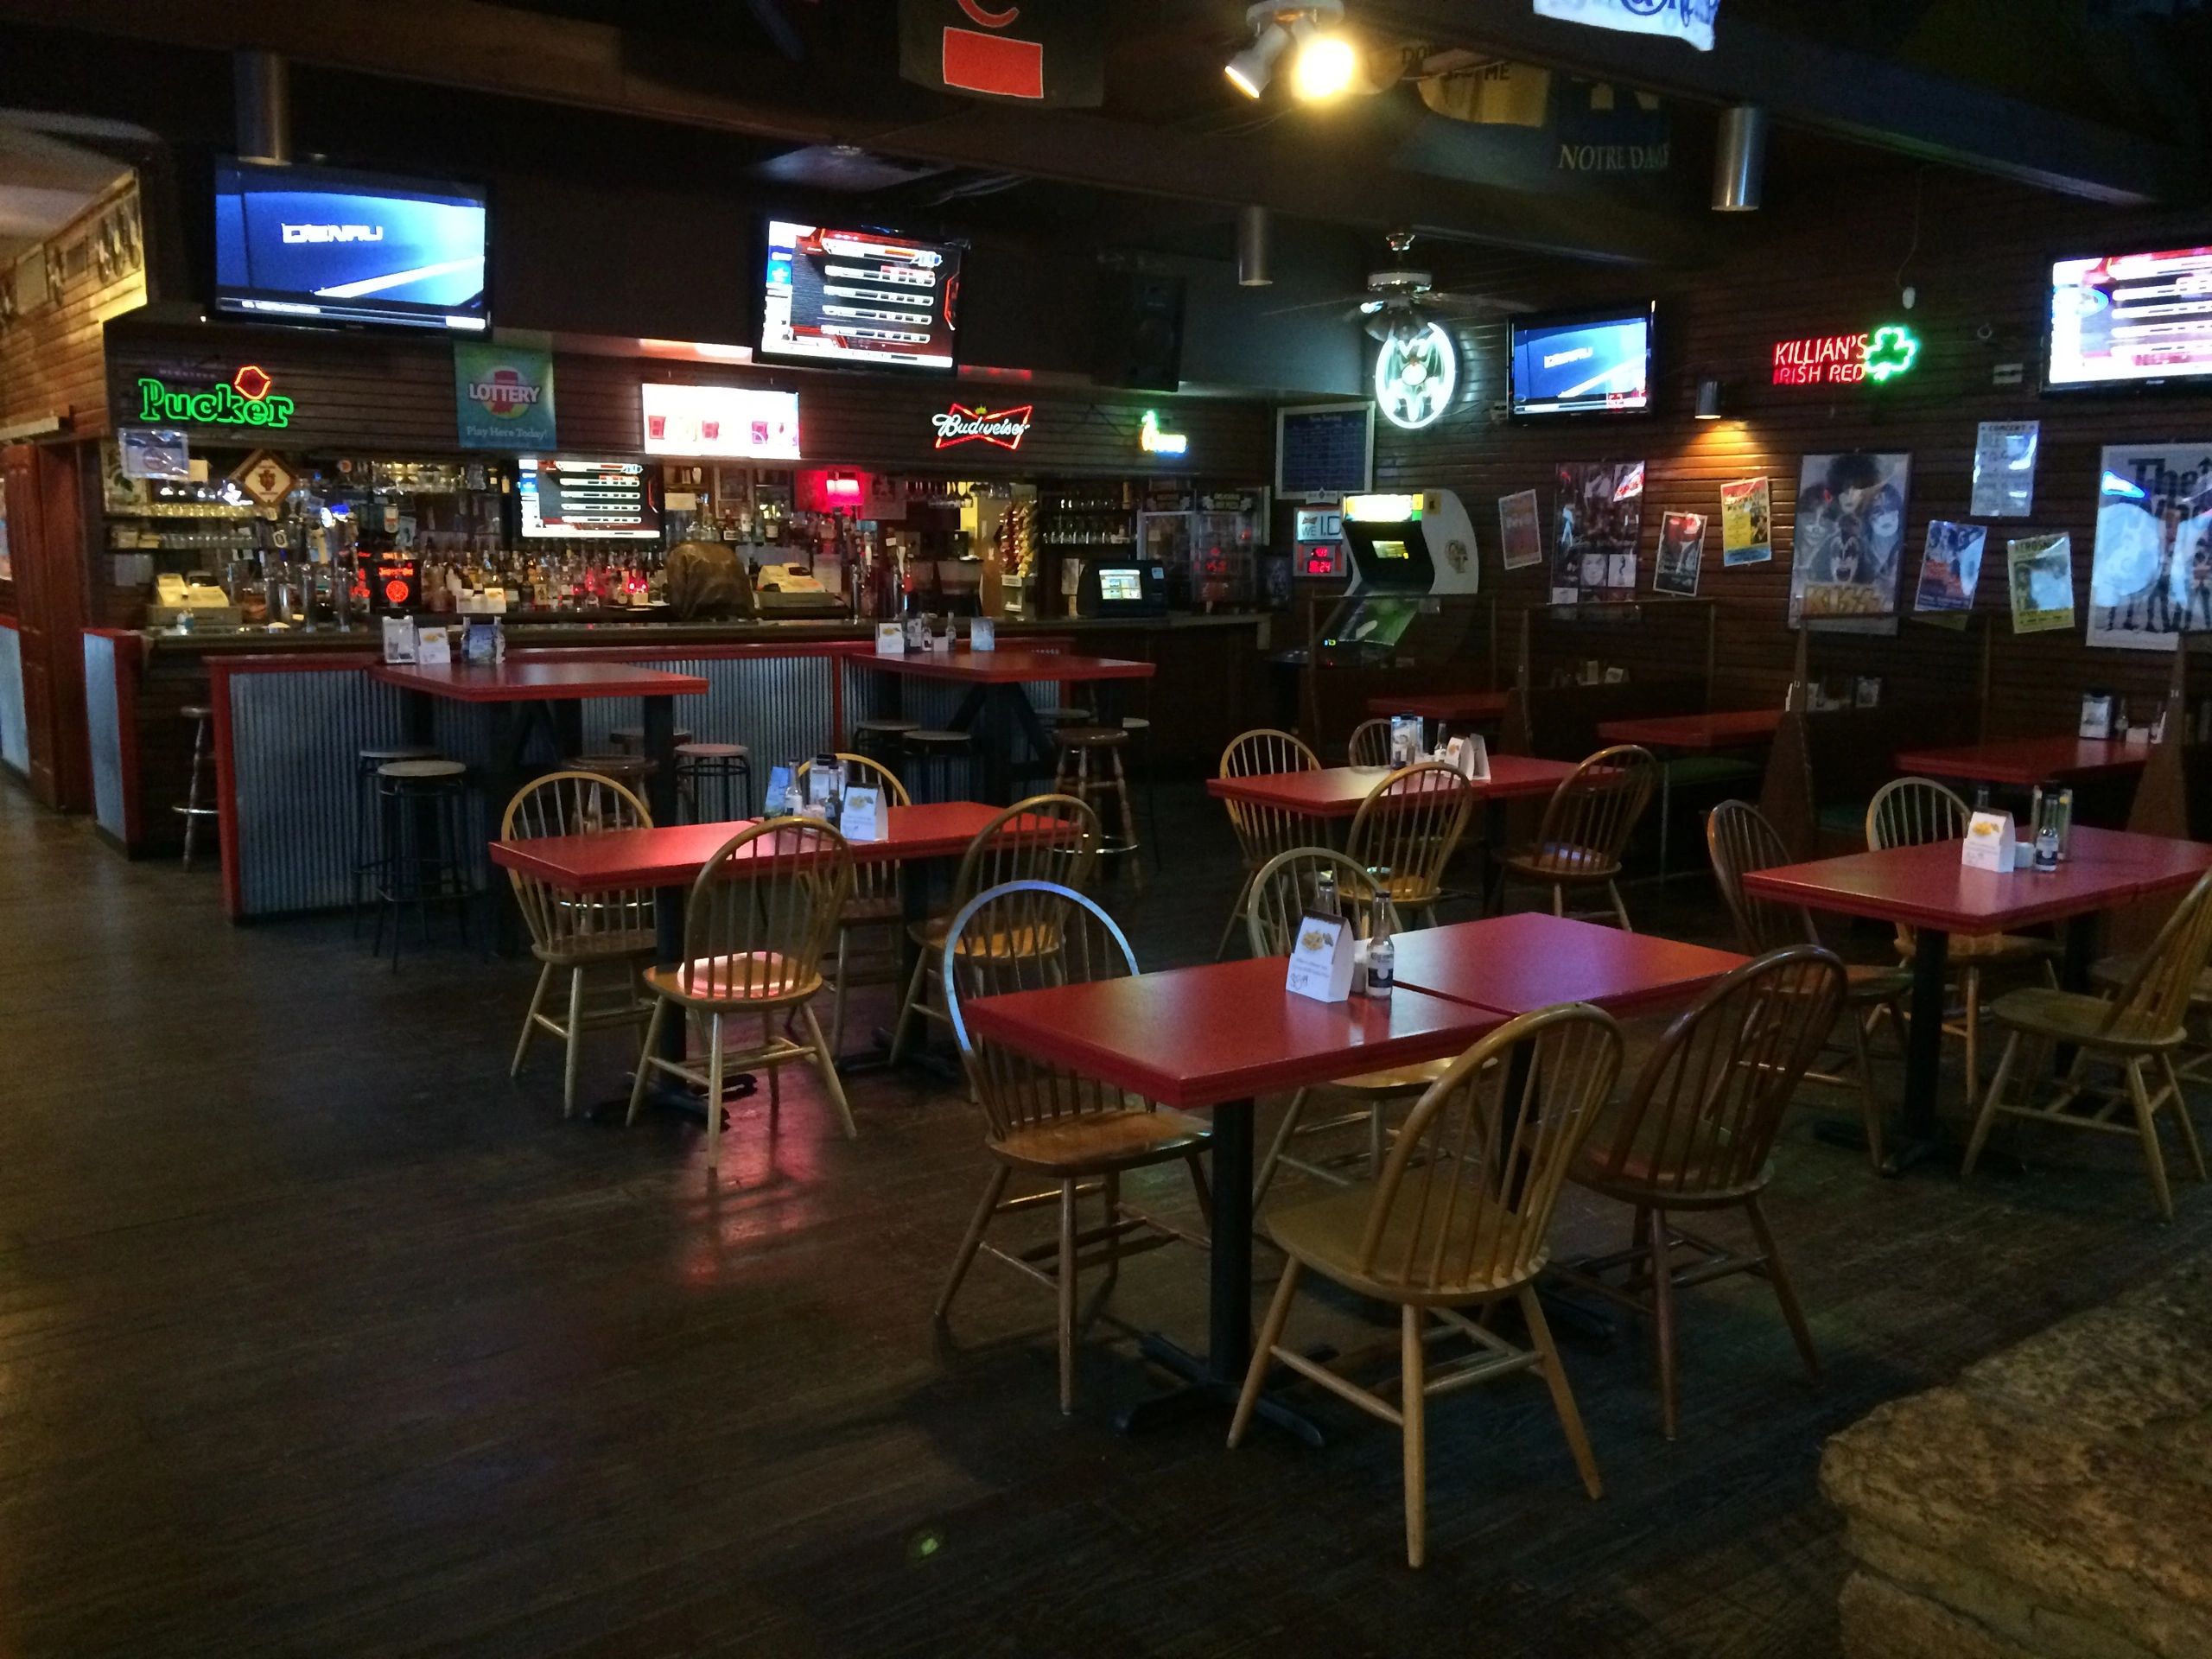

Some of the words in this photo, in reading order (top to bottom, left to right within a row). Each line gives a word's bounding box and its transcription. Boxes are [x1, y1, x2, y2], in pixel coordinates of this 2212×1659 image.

[1558, 143, 1625, 170] NOTRE
[1775, 334, 1869, 365] KILLIAN'S
[1773, 365, 1821, 385] IRISH
[1828, 364, 1866, 383] RED
[137, 378, 295, 428] Pucker
[469, 383, 541, 404] LOTTERY
[467, 426, 486, 437] Play
[490, 427, 513, 437] Here
[516, 428, 547, 441] Today!
[931, 414, 1031, 437] Budweiser
[2128, 458, 2199, 497] The
[1301, 526, 1317, 537] WE
